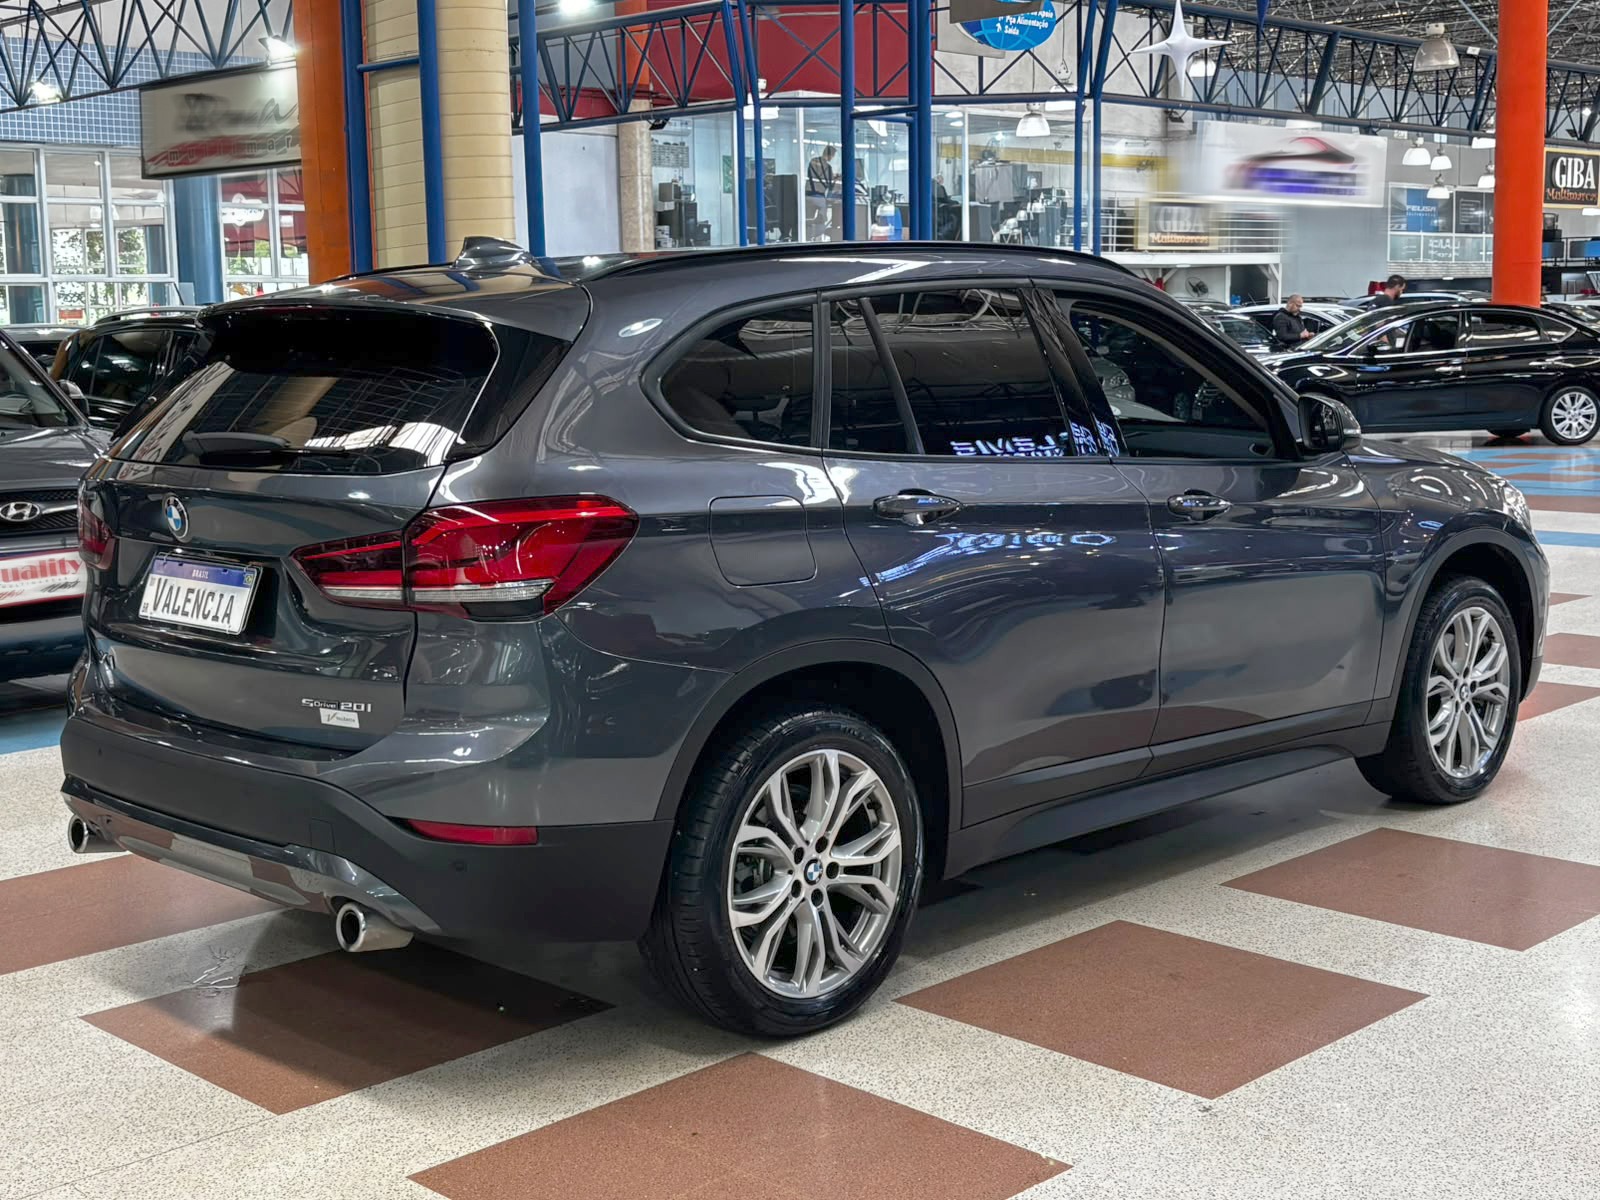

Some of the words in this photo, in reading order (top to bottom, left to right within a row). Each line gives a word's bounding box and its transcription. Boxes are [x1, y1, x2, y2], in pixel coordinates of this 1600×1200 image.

[1555, 156, 1596, 189] GIBA
[1158, 206, 1205, 232] GIBA
[0, 557, 83, 583] uality
[192, 568, 209, 579] BRASIL
[152, 577, 235, 624] VALENCIA
